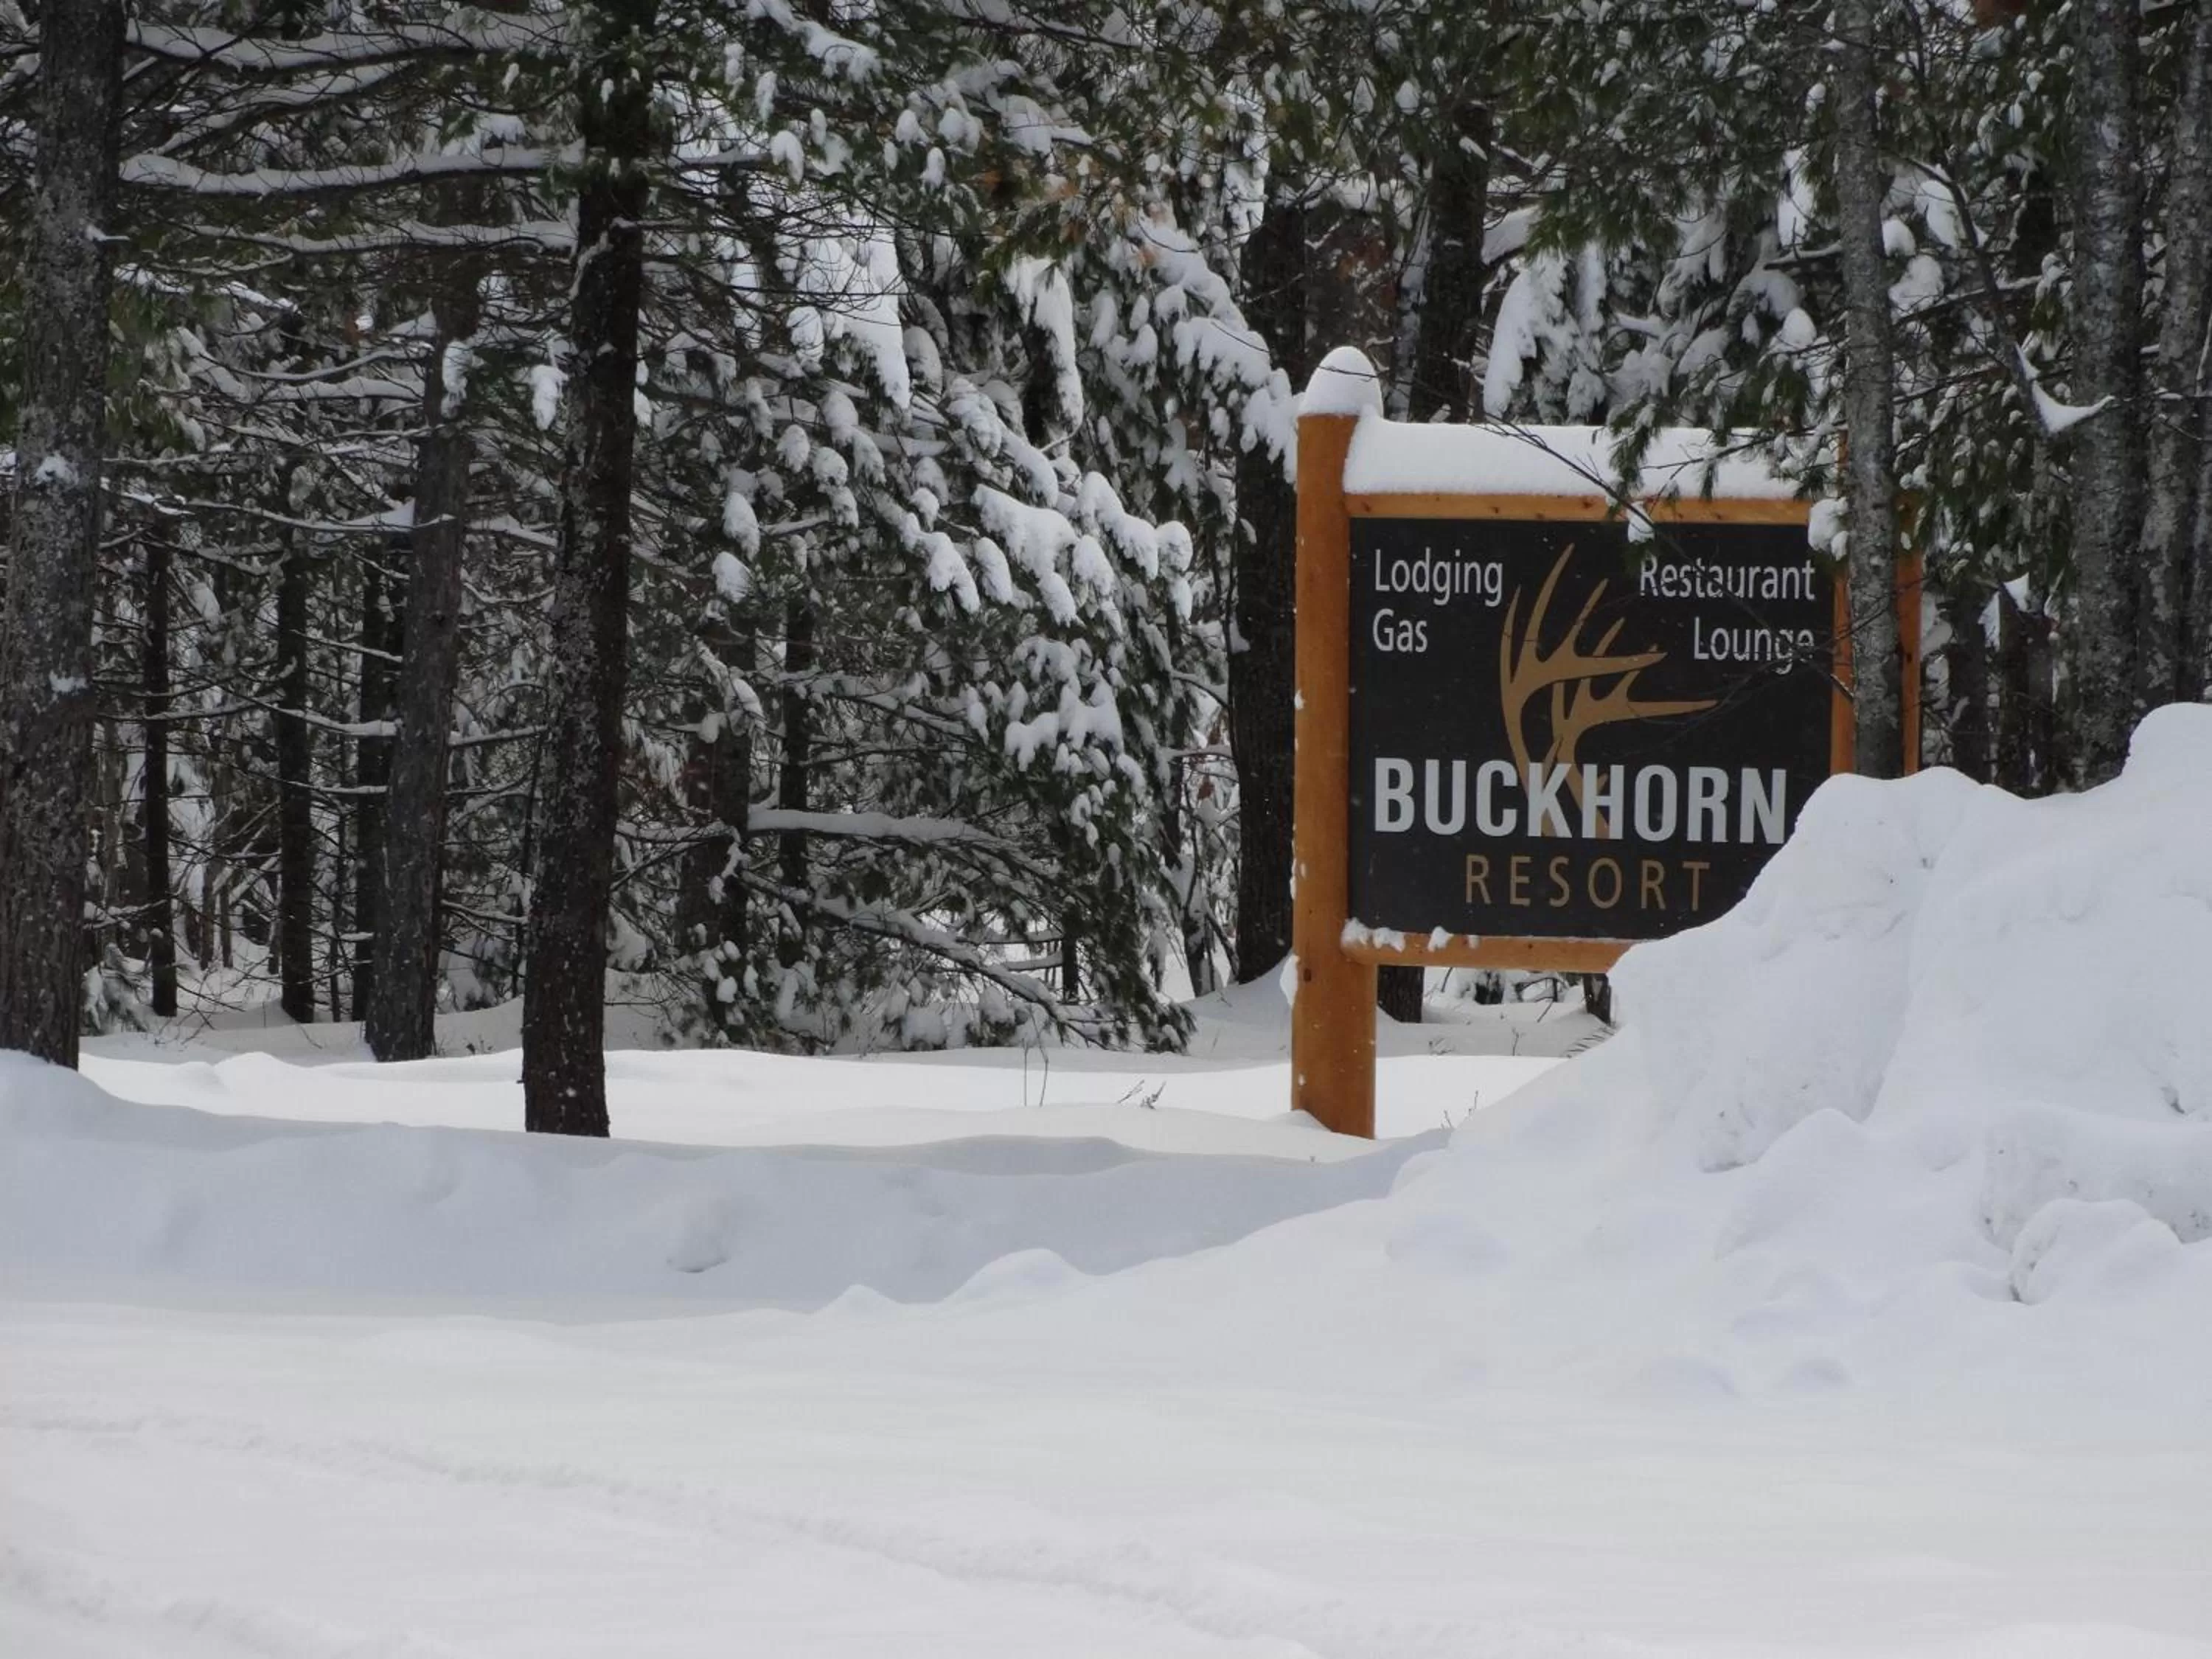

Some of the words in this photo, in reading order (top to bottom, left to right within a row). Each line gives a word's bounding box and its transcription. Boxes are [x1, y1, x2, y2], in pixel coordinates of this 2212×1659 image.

[1374, 548, 1503, 606] Lodging
[1640, 556, 1815, 601] Restaurant
[1372, 609, 1428, 653] Gas
[1694, 617, 1815, 674] Lounge
[1374, 757, 1787, 844] BUCKHORN
[1466, 855, 1711, 911] RESORT
